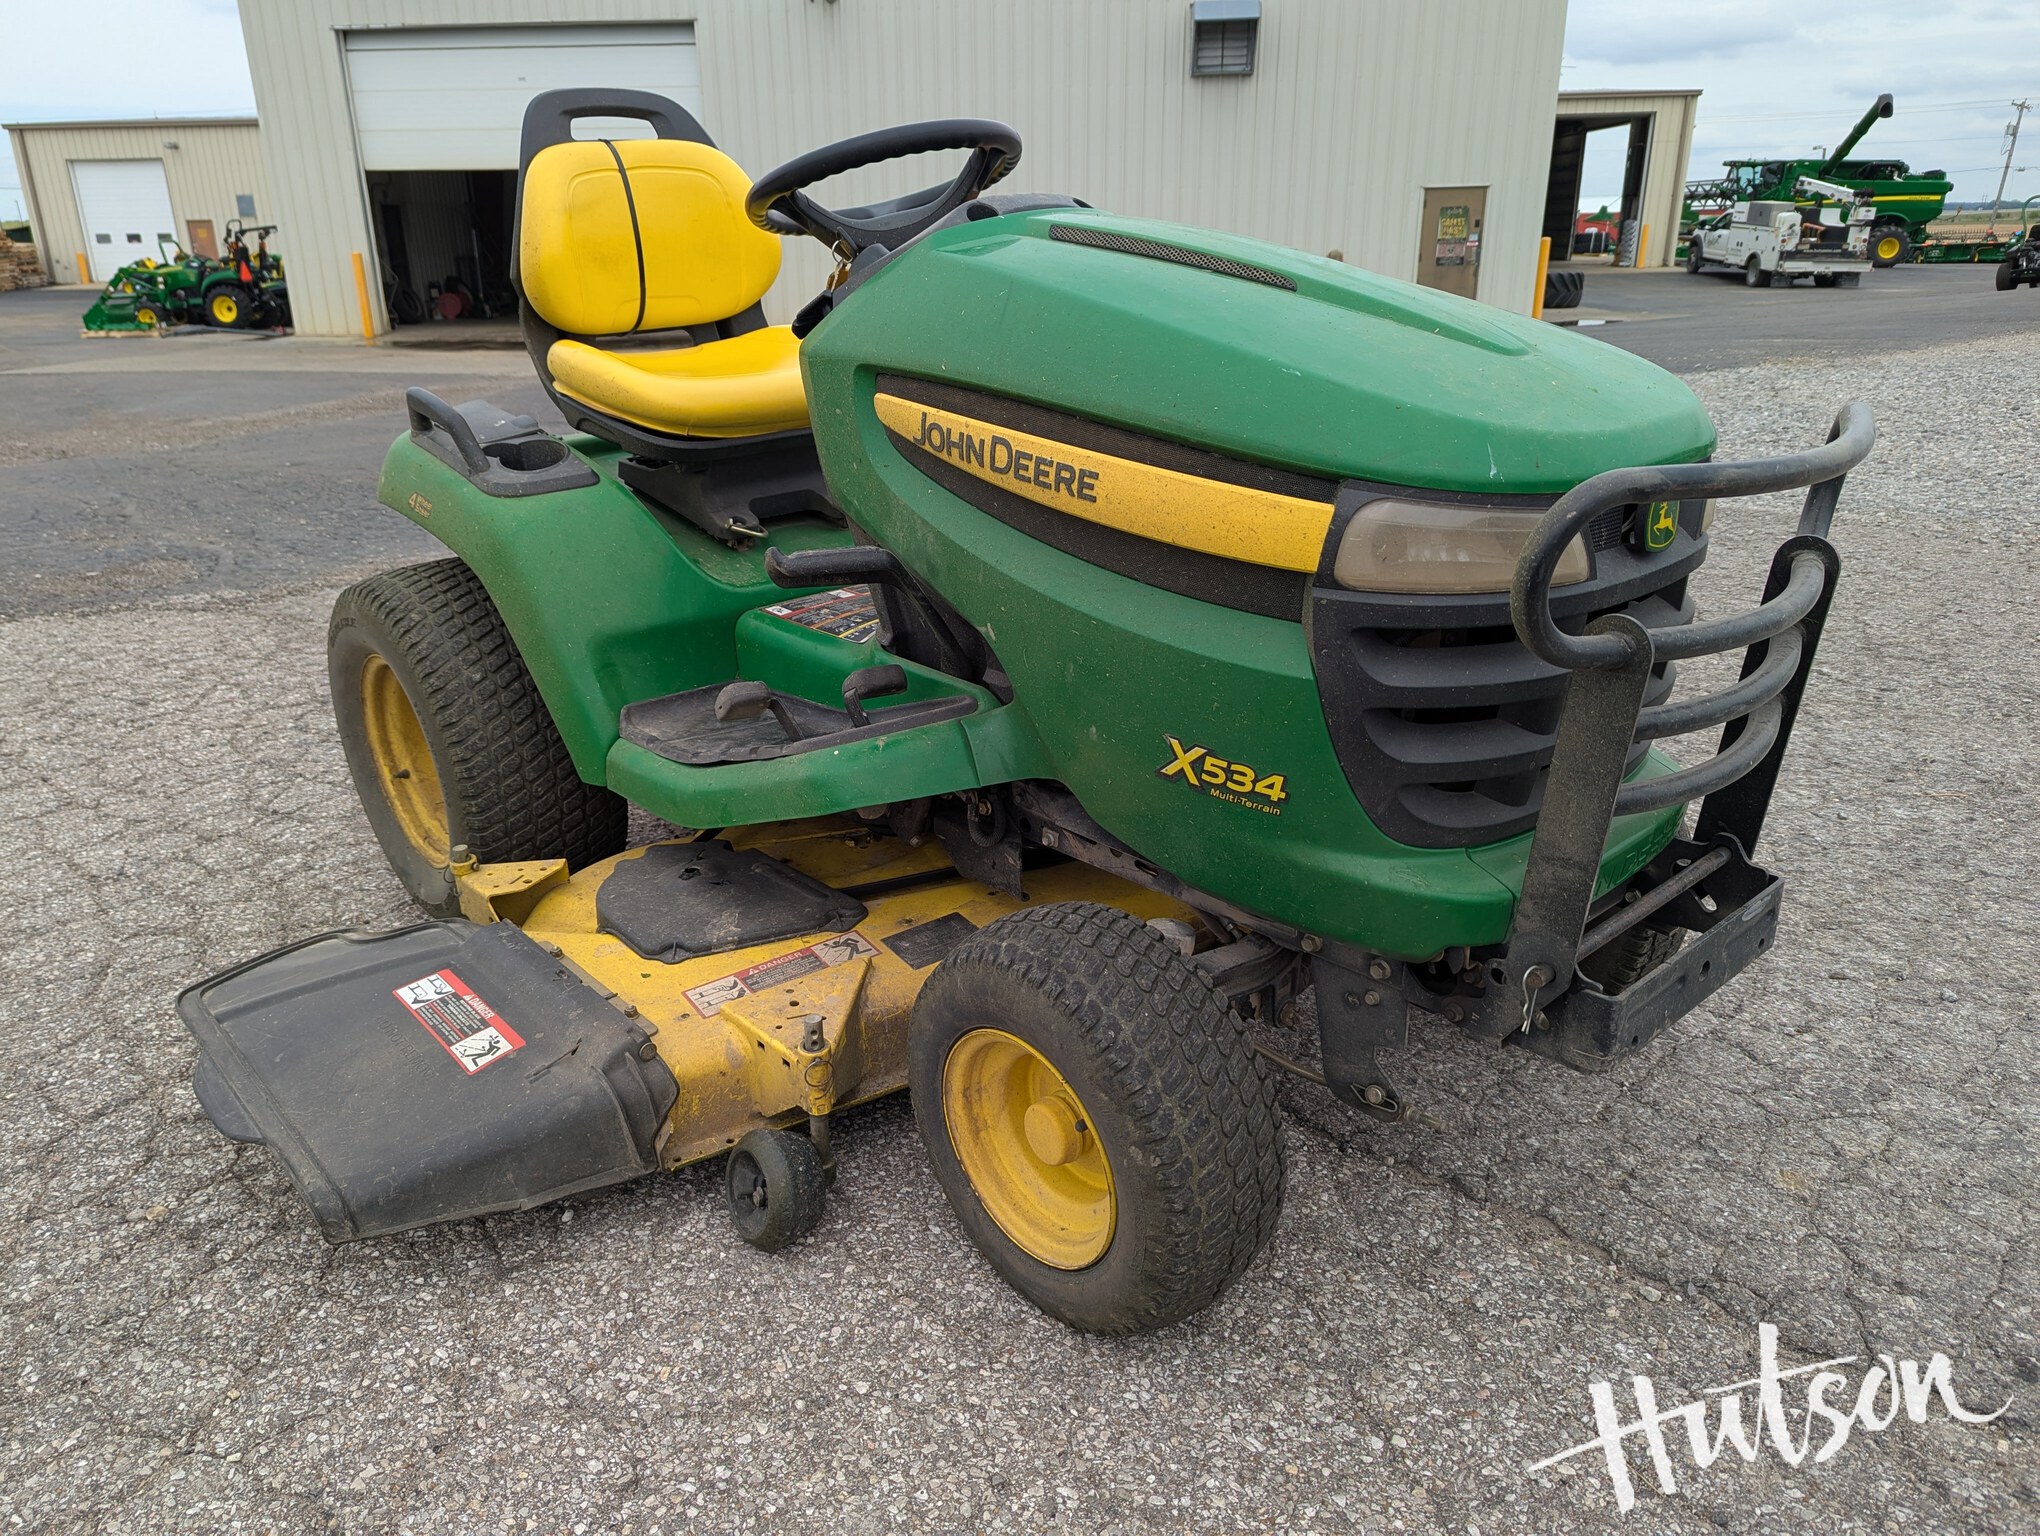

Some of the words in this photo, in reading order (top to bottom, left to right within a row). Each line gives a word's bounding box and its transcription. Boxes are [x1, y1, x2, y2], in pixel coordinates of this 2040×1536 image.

[912, 411, 985, 466] JOHN
[989, 435, 1100, 503] DEERE
[1160, 734, 1287, 802] X534
[1210, 787, 1281, 816] Multi-Terrain
[759, 952, 802, 971] DANGER
[468, 997, 495, 1020] DANGER
